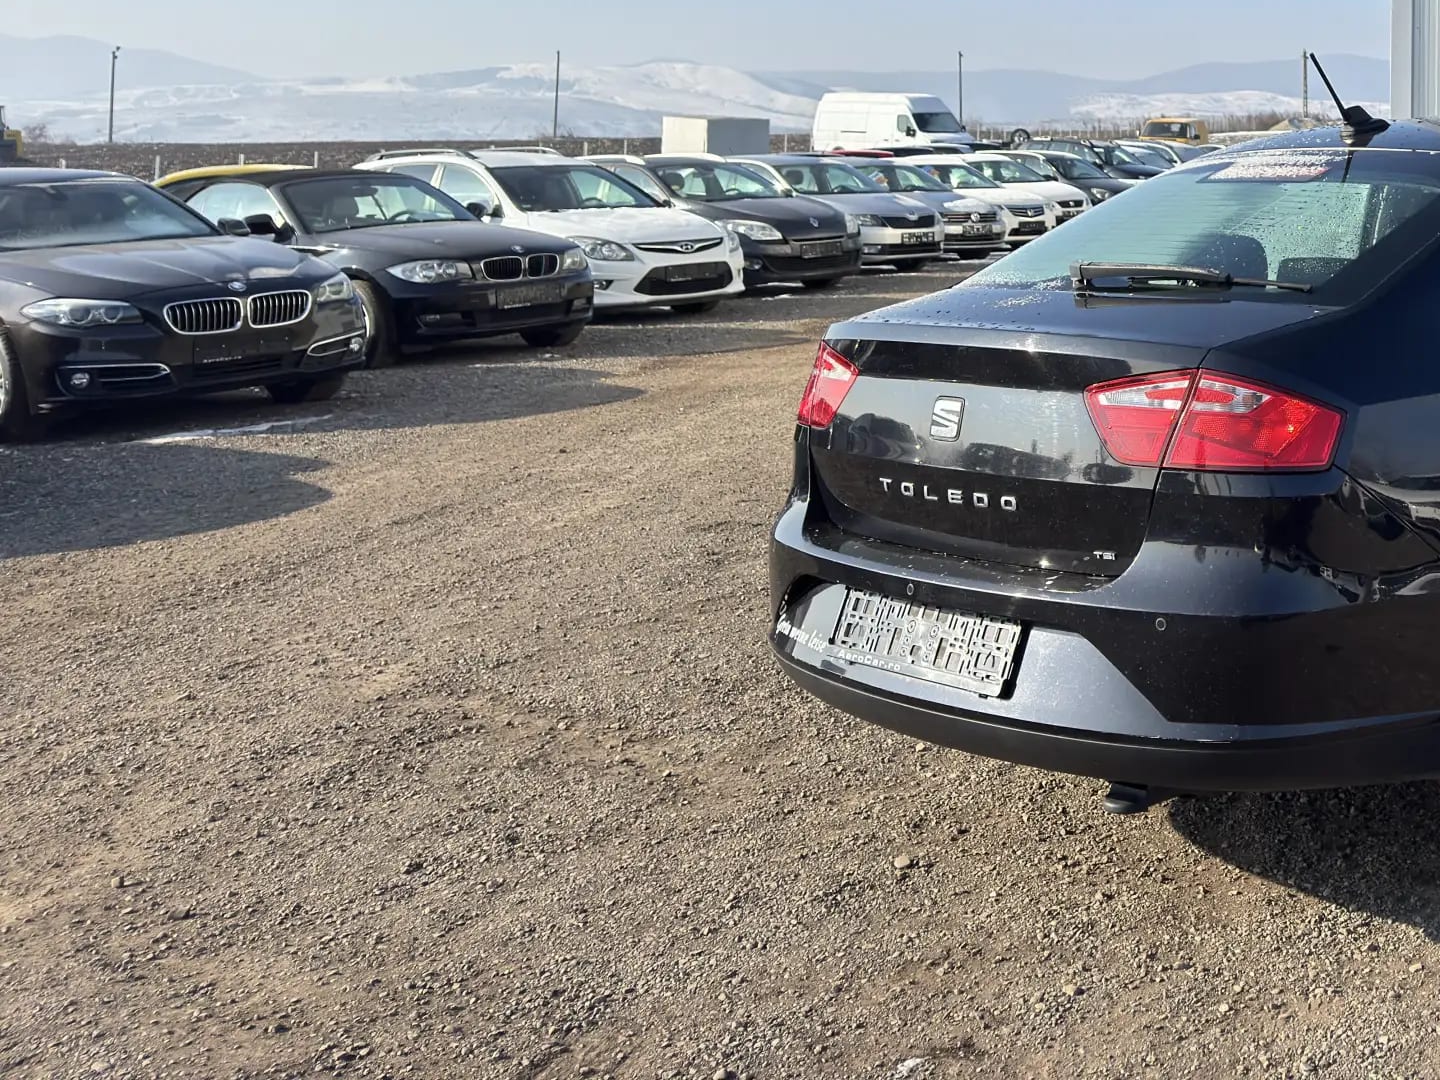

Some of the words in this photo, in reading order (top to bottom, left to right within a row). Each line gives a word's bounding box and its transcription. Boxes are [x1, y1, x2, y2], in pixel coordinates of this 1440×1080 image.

[879, 477, 1017, 511] TOLEDO
[1093, 551, 1117, 561] TSI
[836, 649, 901, 671] AeroCar.ro
